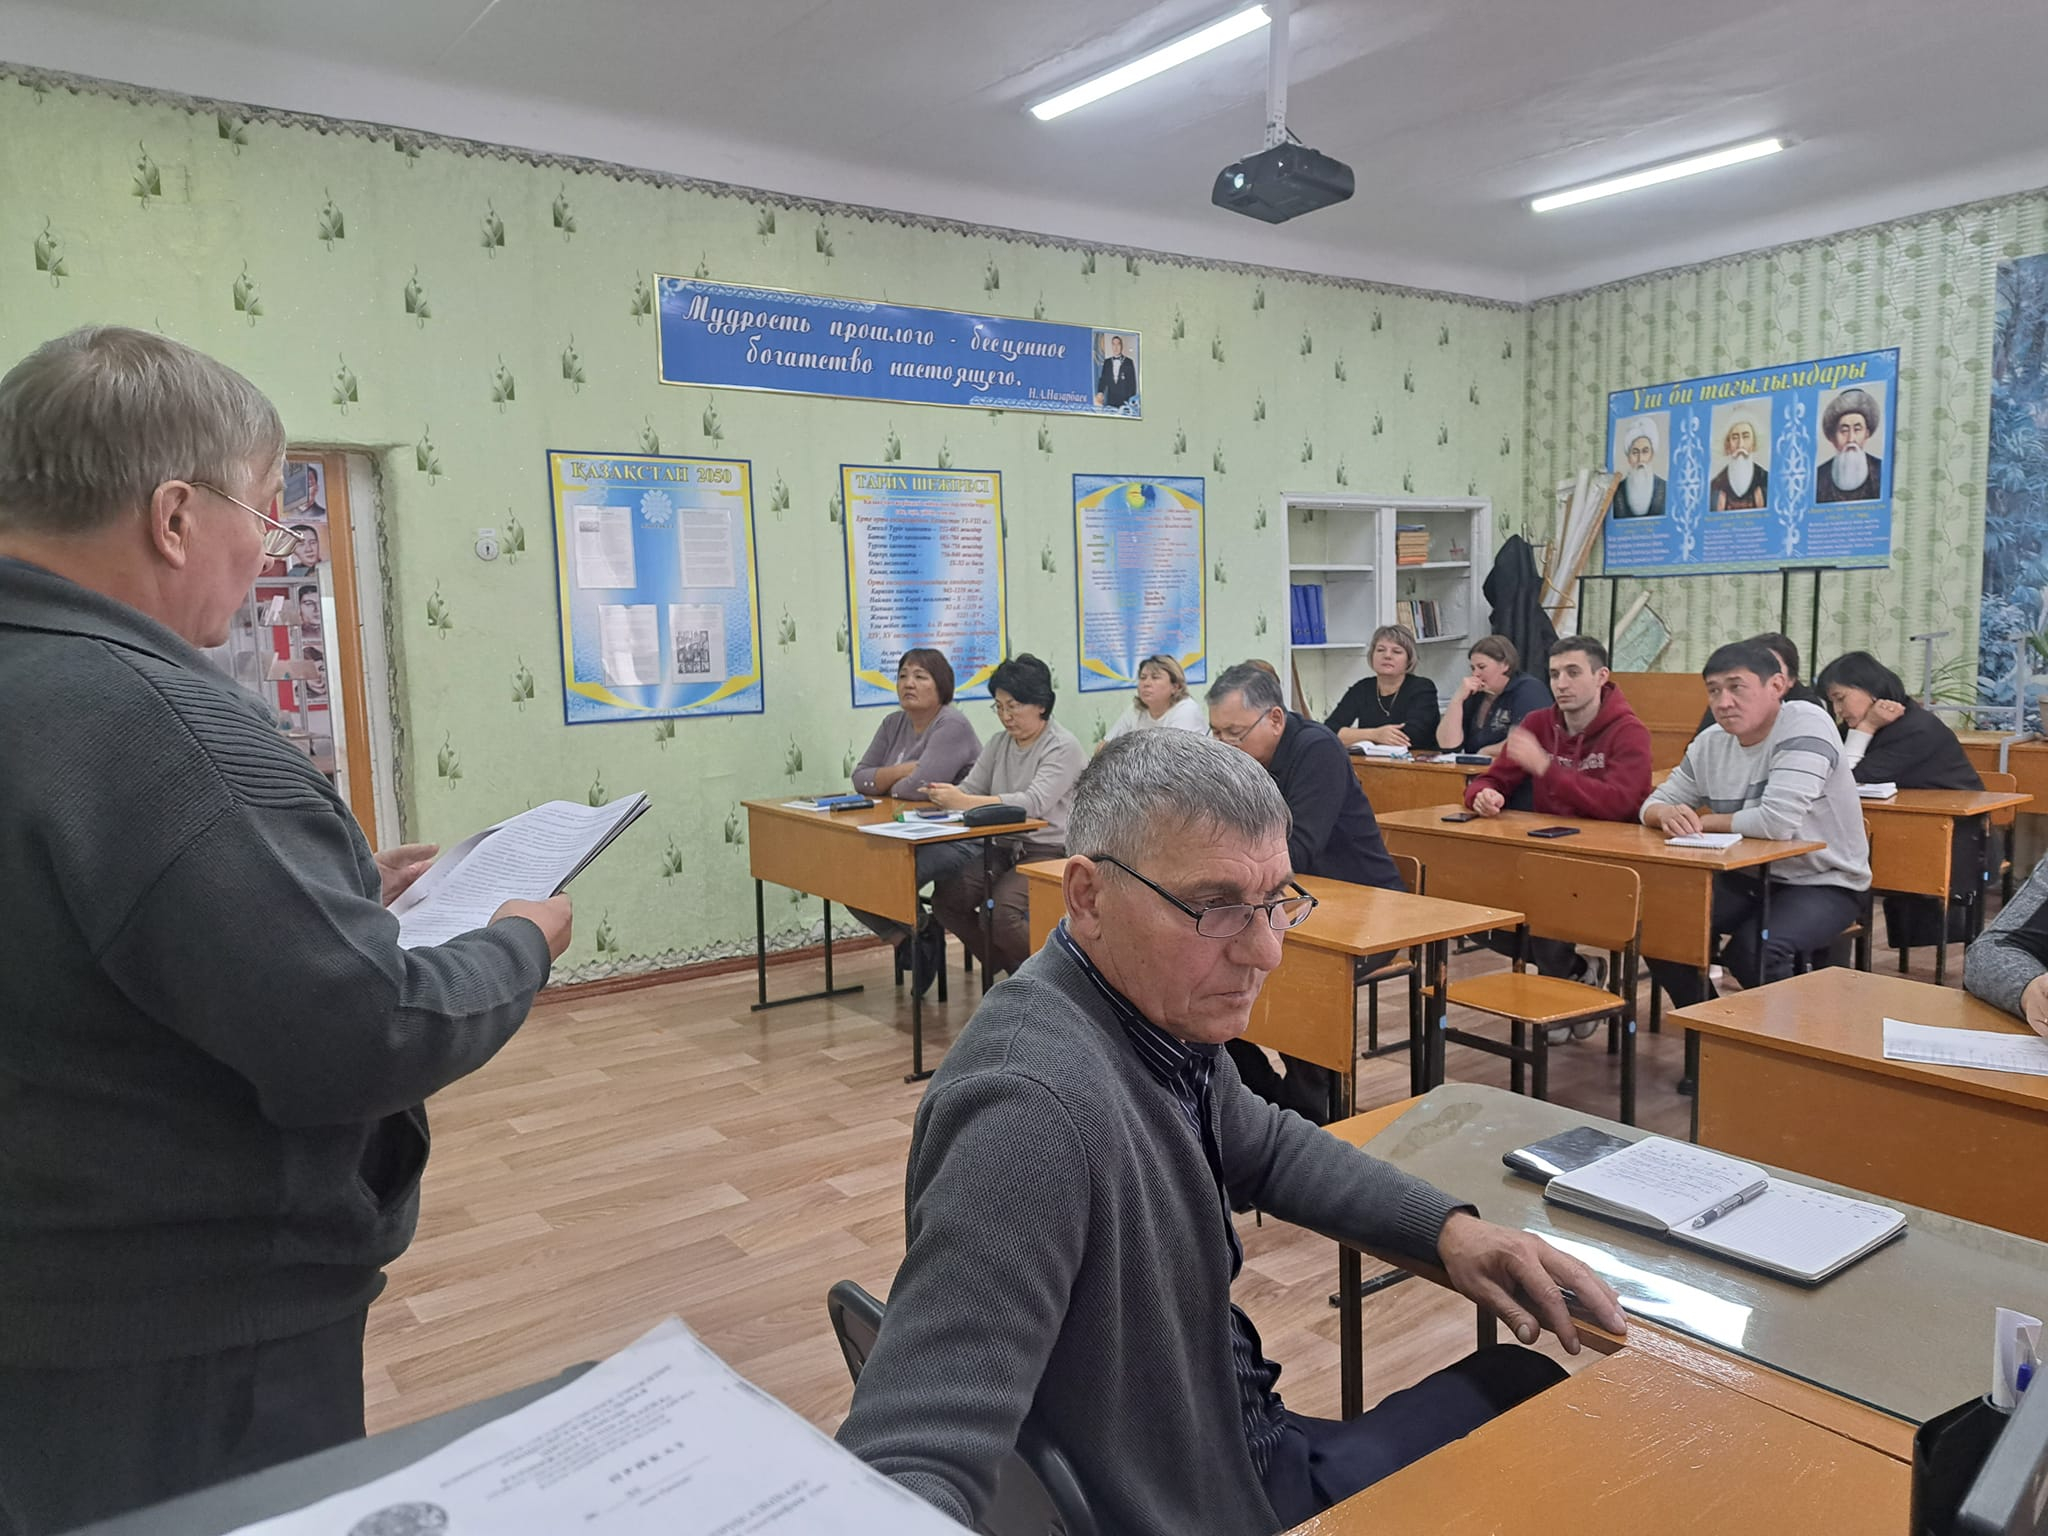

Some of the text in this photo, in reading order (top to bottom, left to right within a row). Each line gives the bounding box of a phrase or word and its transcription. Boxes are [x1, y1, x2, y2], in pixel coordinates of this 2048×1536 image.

[682, 294, 812, 336] Мудрость
[829, 320, 935, 346] прошлого
[970, 323, 1067, 362] бесценное
[746, 333, 1022, 392] богатство настоящего.
[1668, 383, 1694, 406] би
[571, 461, 733, 484] ҚАЗАҚСТАН 2050
[855, 474, 908, 491] ТАРИХ
